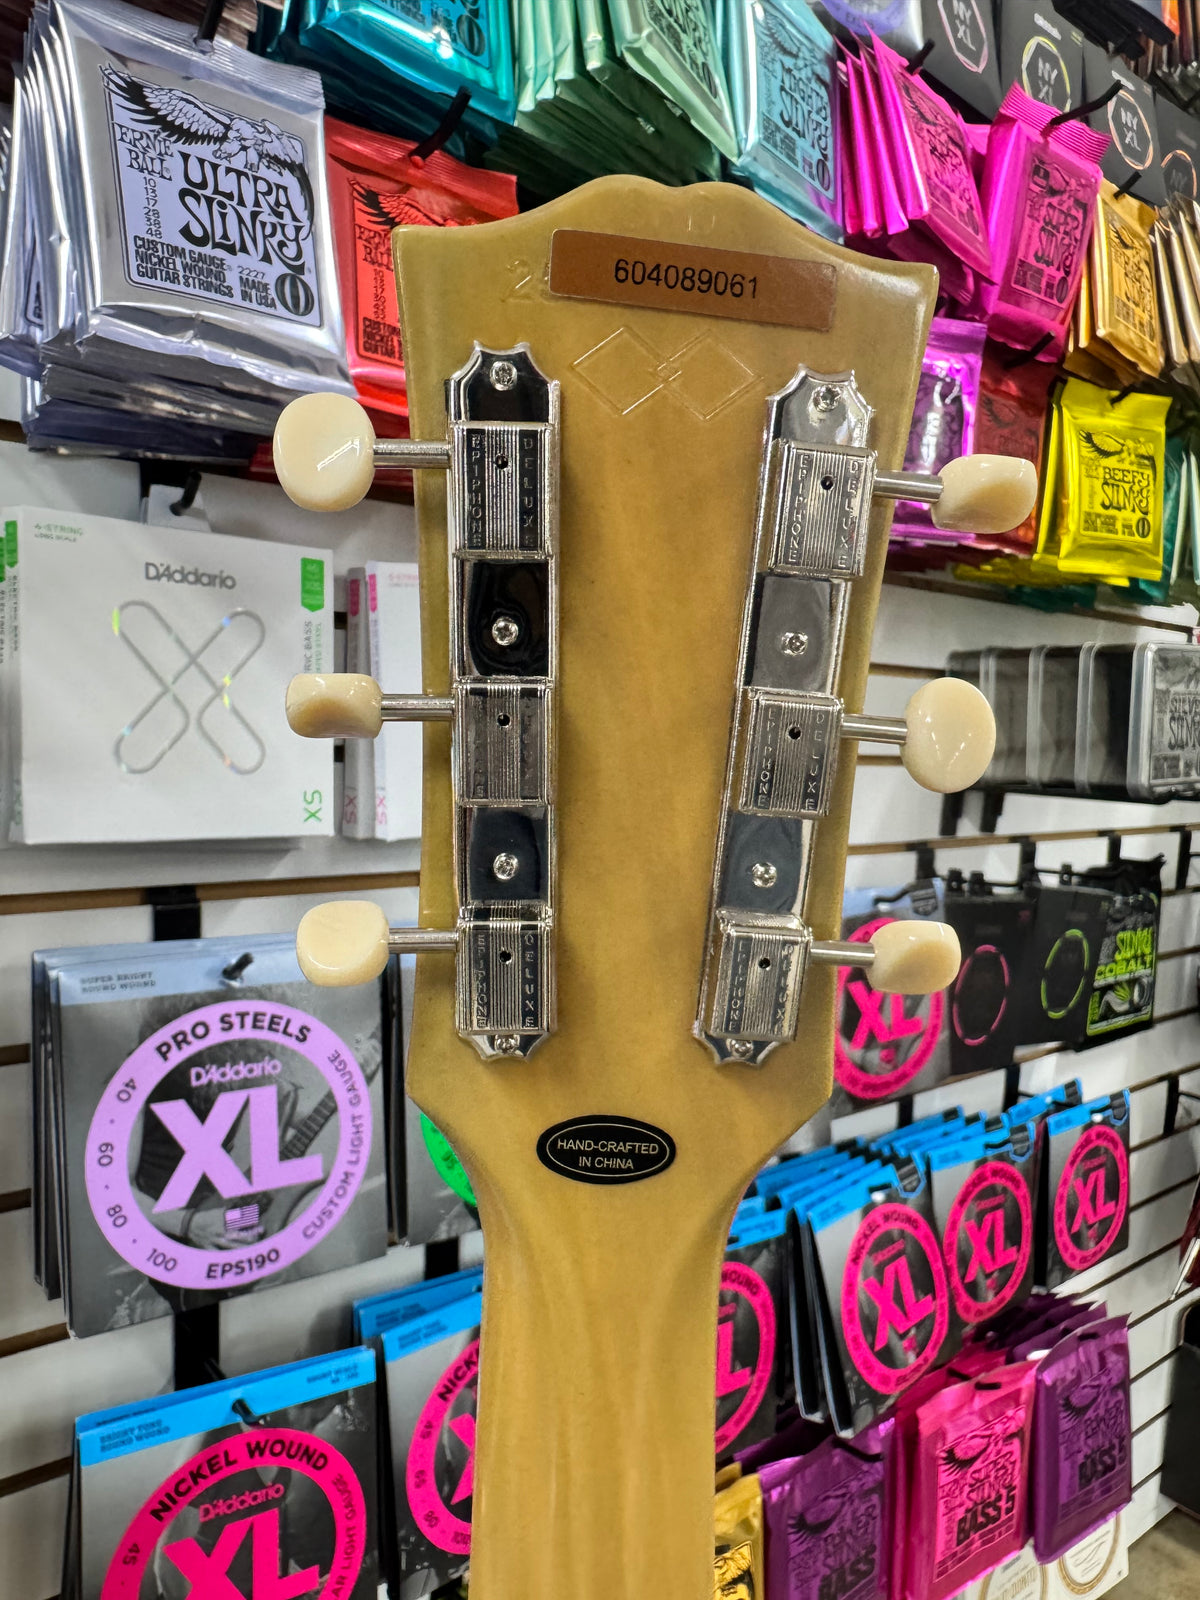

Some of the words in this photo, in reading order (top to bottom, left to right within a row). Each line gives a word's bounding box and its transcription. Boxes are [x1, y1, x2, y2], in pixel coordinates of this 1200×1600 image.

[114, 123, 174, 158] ERNIE
[127, 148, 172, 181] BALL
[144, 176, 157, 188] 10
[178, 151, 305, 224] ULTRA
[134, 236, 187, 259] CUSTOM
[189, 248, 227, 271] GAUGE
[135, 250, 180, 272] NICKEL
[182, 260, 226, 283] WOUND
[137, 265, 180, 286] GUITAR
[183, 275, 234, 298] STRINGS
[237, 265, 265, 279] 2227
[239, 275, 271, 295] MADE
[614, 258, 758, 299] 604089061
[241, 290, 253, 302] IN
[255, 293, 277, 310] USA
[1103, 466, 1150, 488] BEEFY
[788, 454, 811, 562] EPIPHONE
[144, 562, 237, 590] D'Addario
[757, 707, 776, 807] EPIPHONE
[303, 789, 322, 822] XS
[524, 931, 535, 1028] DELUXE
[1095, 955, 1152, 981] COBALT
[846, 980, 923, 1050] XL
[156, 1021, 210, 1061] PRO
[219, 1011, 311, 1043] STEELS
[190, 1056, 282, 1087] D'Addario
[327, 1049, 362, 1107] GAUGE
[117, 1078, 137, 1102] 40
[98, 1142, 114, 1167] 60
[149, 1083, 324, 1214] XL
[347, 1114, 364, 1166] LIGHT
[557, 1138, 659, 1155] HAND-CRAFTED
[578, 1156, 591, 1167] IN
[595, 1156, 634, 1169] CHINA
[106, 1204, 128, 1228] 80
[302, 1170, 355, 1239] CUSTOM
[1071, 1167, 1116, 1234] XL
[146, 1248, 177, 1272] 100
[963, 1208, 1018, 1283] XL
[206, 1248, 280, 1279] EPS190
[863, 1254, 935, 1352] XL
[149, 1450, 238, 1522] NICKEL
[246, 1439, 328, 1471] WOUND
[956, 1493, 1003, 1547] BASS
[1005, 1485, 1017, 1516] 5
[162, 1507, 320, 1600] XL
[342, 1526, 357, 1570] LIGHT
